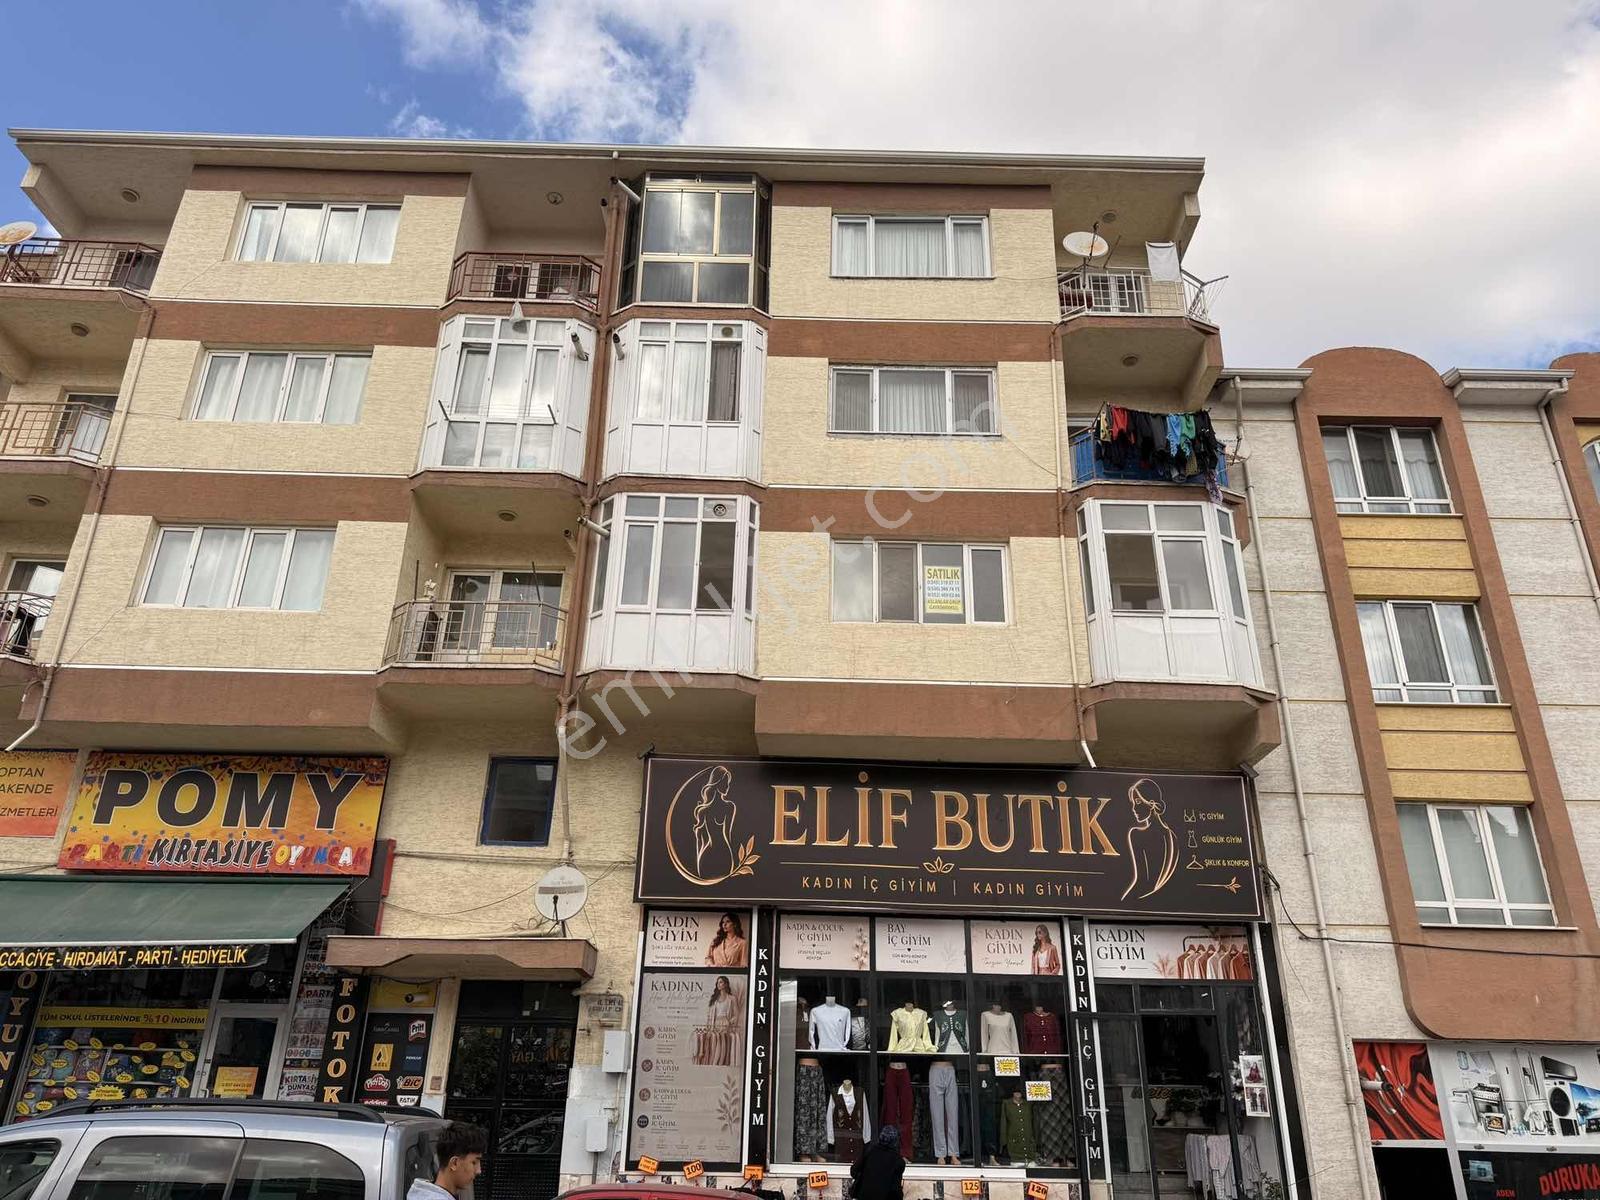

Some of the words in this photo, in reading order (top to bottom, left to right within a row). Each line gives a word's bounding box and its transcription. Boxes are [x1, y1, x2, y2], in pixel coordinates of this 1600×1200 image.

[927, 568, 960, 580] SATILIK
[92, 769, 367, 830] POMY
[769, 771, 913, 849] ELİF
[930, 780, 1120, 856] BUTİK
[1207, 812, 1224, 820] GİYİM
[1202, 835, 1225, 844] GÜNLÜK
[146, 830, 275, 868] KIRTASİYE
[275, 844, 369, 866] OYUNCAK
[802, 876, 852, 889] KADIN
[863, 876, 878, 892] İÇ
[889, 878, 937, 893] GİYİM
[973, 881, 1025, 896] KADIN
[1036, 882, 1084, 897] GİYİM
[652, 916, 700, 928] KADIN
[887, 923, 907, 933] BAY
[653, 928, 698, 942] GİYİM
[807, 932, 832, 941] GİYİM
[887, 933, 898, 947] İÇ
[900, 934, 931, 946] GİYİM
[985, 929, 1024, 939] KADIN
[1095, 928, 1146, 943] KADIN
[987, 940, 1022, 954] GİYİM
[1096, 943, 1146, 961] GİYİM
[63, 951, 126, 967] HIRDAVAT
[135, 947, 171, 965] PARTİ
[181, 946, 247, 965] HEDİYELİK
[1073, 934, 1087, 1009] KADIN
[651, 980, 703, 992] KADININ
[757, 948, 768, 1024] KADIN
[752, 1045, 766, 1126] GİYİM
[685, 1163, 701, 1175] 100
[810, 1174, 826, 1184] 150
[964, 1182, 980, 1191] 125
